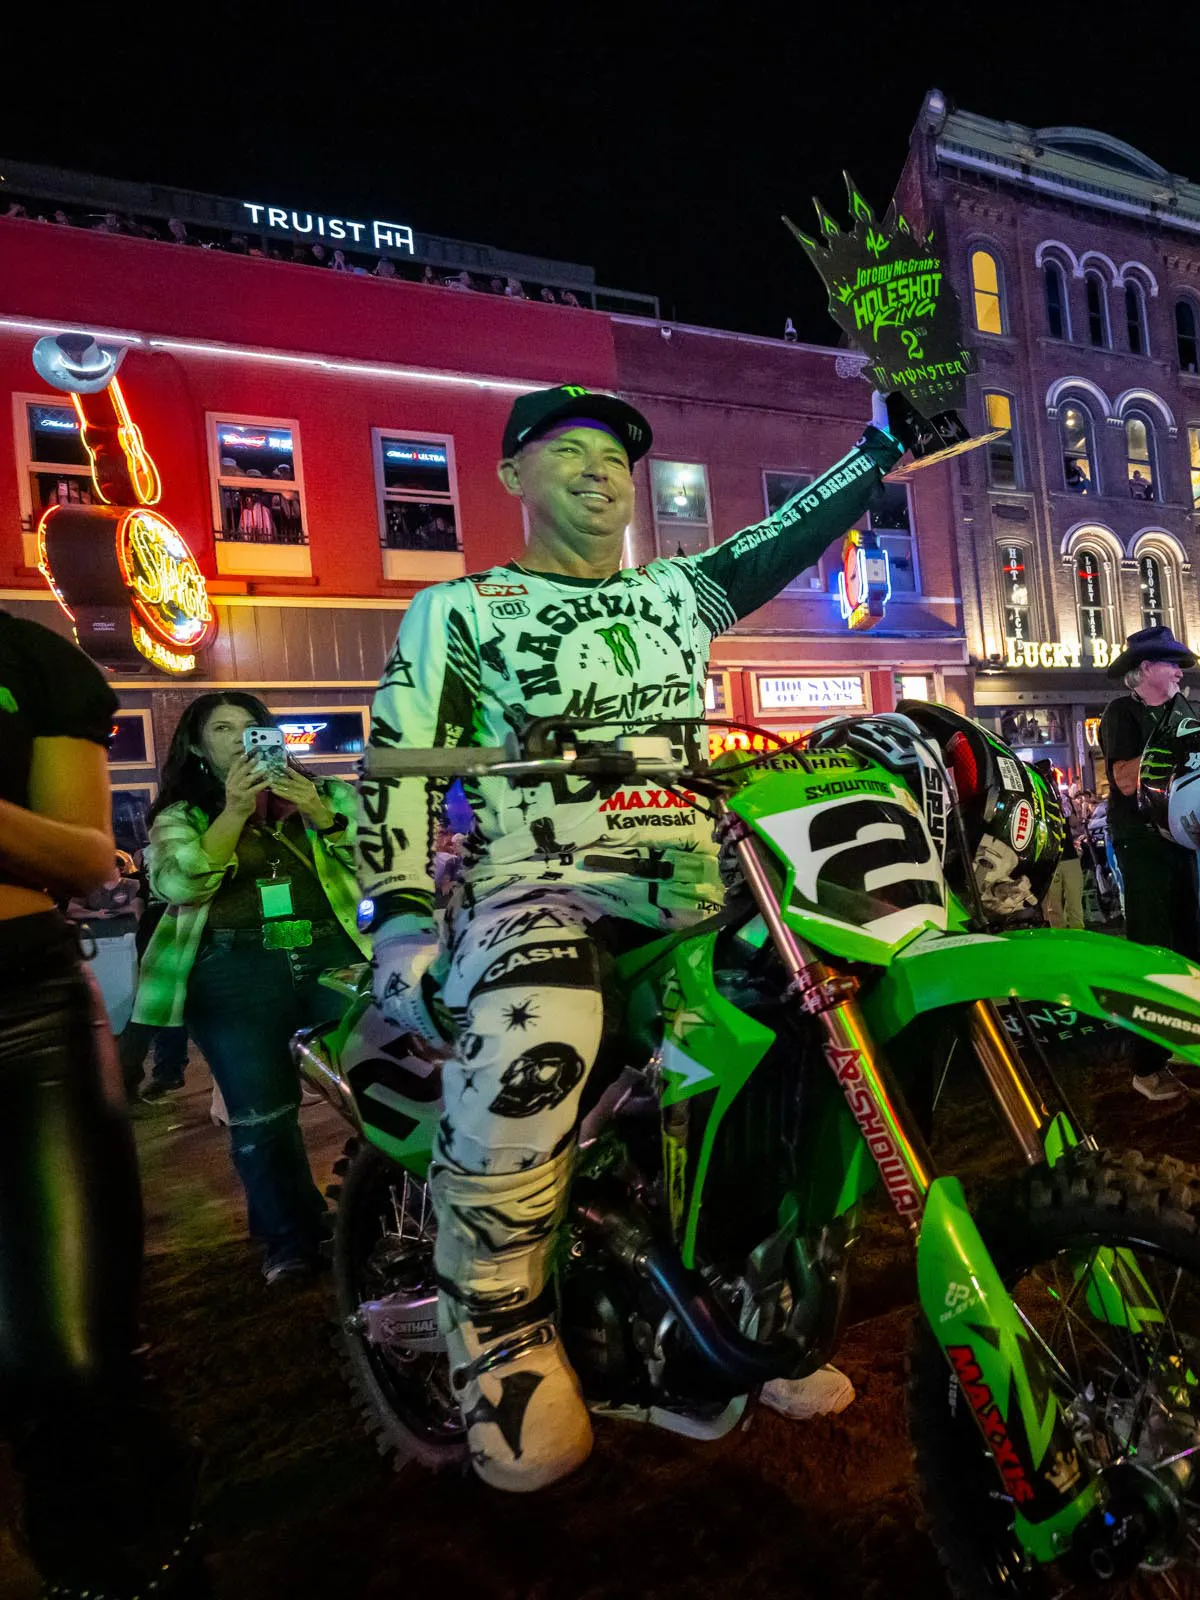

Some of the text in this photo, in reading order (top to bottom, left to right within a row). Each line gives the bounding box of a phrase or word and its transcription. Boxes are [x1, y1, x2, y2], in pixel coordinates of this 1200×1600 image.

[243, 203, 366, 242] TRUIST
[853, 273, 942, 329] HOLESHOT
[874, 299, 937, 343] KING
[891, 360, 967, 387] MONSTER
[800, 494, 820, 512] TO
[1008, 548, 1019, 580] HOT
[1084, 556, 1095, 602] LUCKY
[495, 602, 525, 616] 101
[1005, 640, 1082, 668] LUCKY
[755, 757, 854, 772] RENHAL
[805, 779, 891, 801] SHOWTIME
[606, 809, 697, 832] Kawasaki
[1015, 807, 1029, 842] BELL
[808, 799, 946, 932] 2
[485, 944, 579, 982] CASH
[945, 1344, 1036, 1505] MAXXIS
